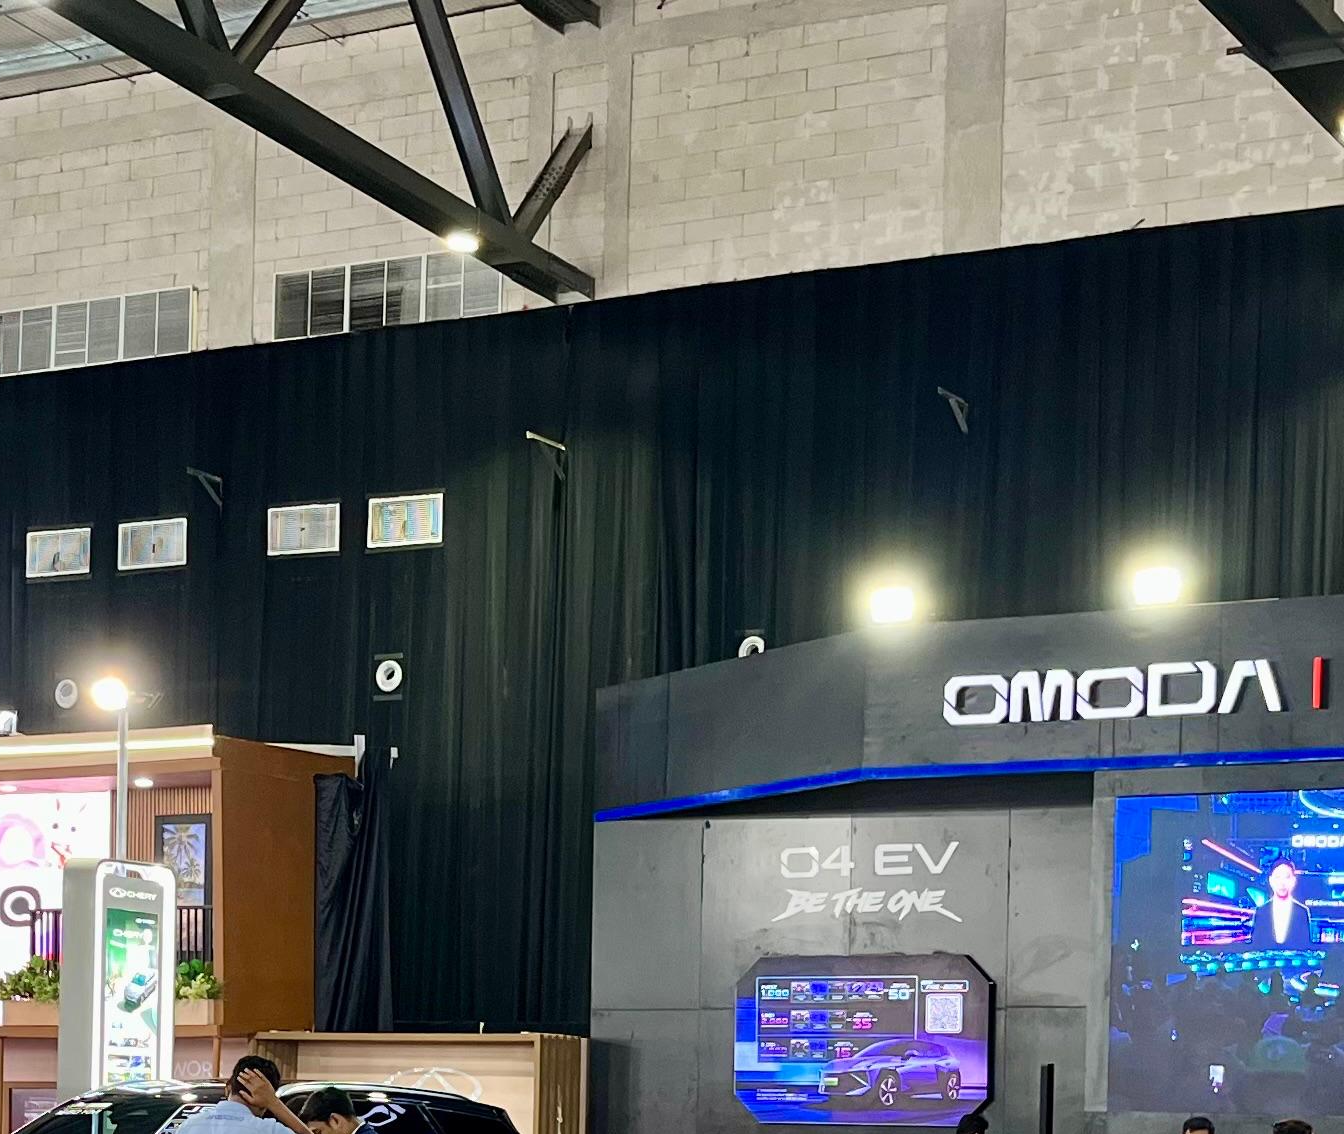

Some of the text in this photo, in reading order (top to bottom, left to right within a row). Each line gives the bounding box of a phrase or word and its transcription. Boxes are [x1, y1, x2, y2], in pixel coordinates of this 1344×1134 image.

[943, 659, 1284, 727] OMODA
[874, 841, 960, 876] EV
[770, 887, 963, 923] BE THE ONE
